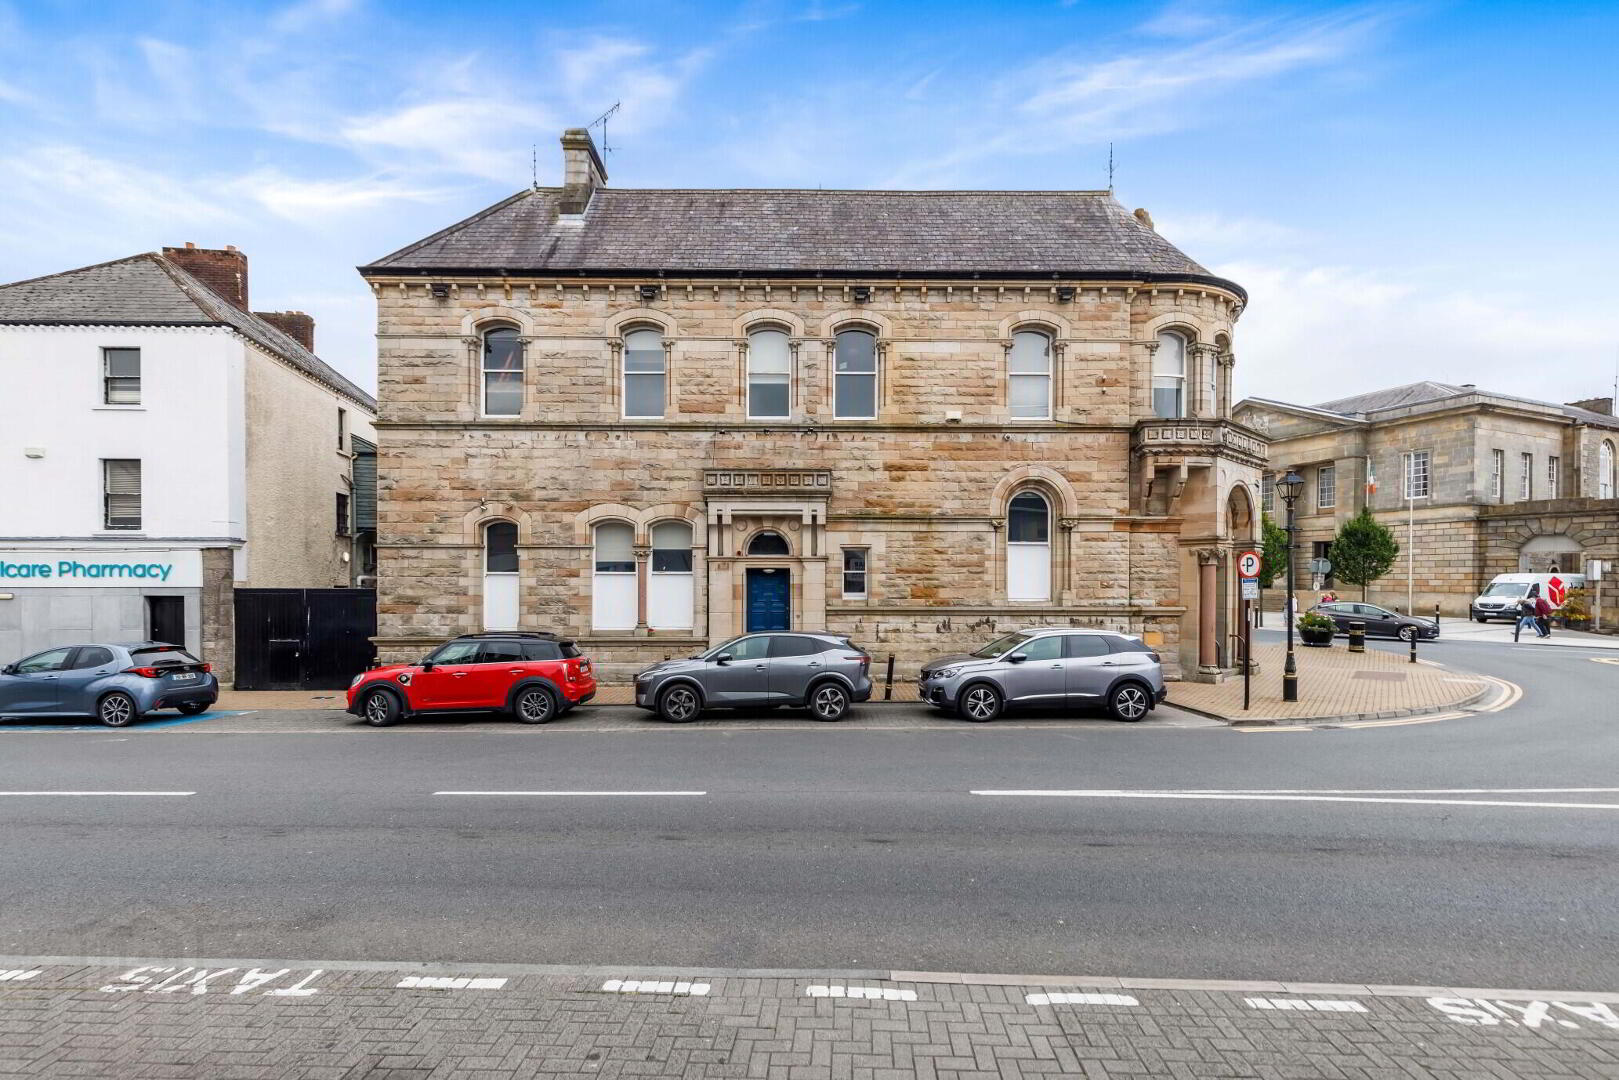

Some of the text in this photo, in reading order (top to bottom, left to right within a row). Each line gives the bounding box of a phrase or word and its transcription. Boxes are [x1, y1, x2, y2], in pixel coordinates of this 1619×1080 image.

[0, 561, 172, 581] lcare Pharmacy
[99, 966, 323, 996] TAXIS
[1426, 998, 1619, 1028] AXIS
